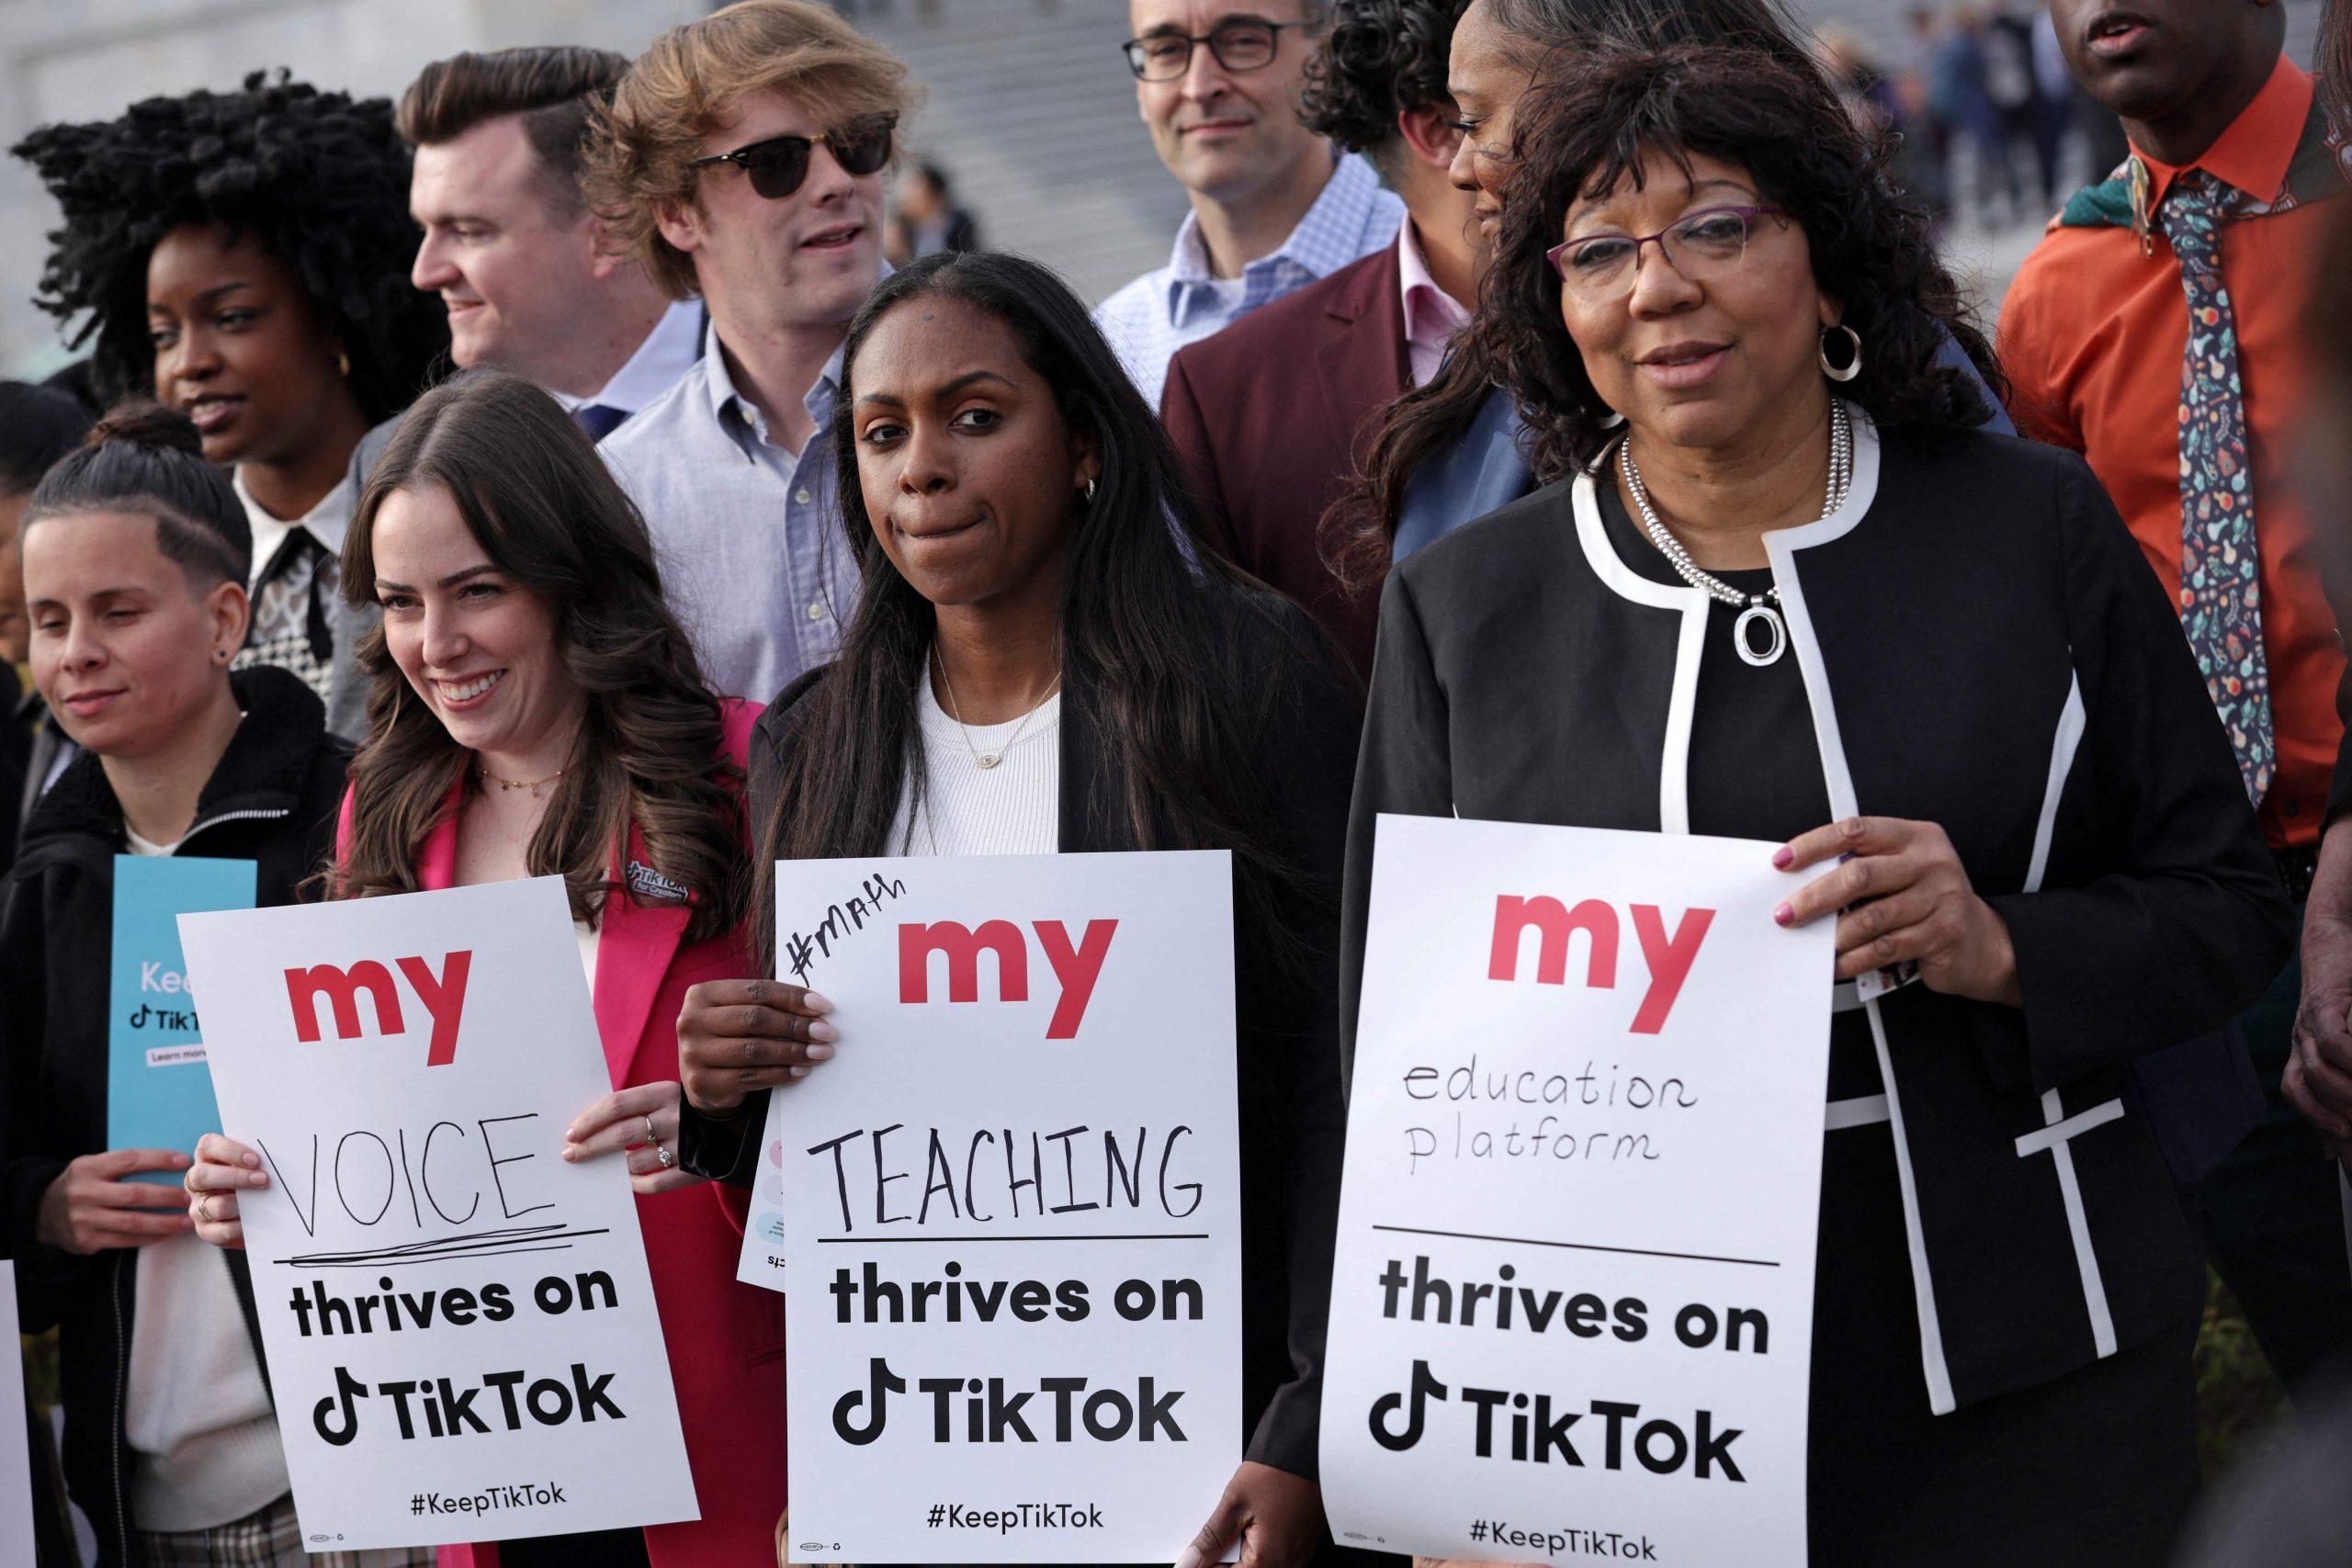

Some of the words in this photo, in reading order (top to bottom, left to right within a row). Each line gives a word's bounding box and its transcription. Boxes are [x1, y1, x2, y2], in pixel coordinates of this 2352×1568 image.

[650, 886, 683, 897] Creator
[899, 919, 1119, 1039] my
[1487, 895, 1717, 1035] my
[284, 950, 472, 1066] my
[152, 1052, 181, 1062] Learn
[1403, 1054, 1699, 1110] education
[257, 1112, 556, 1237] VOICE
[1405, 1111, 1660, 1175] platform
[807, 1123, 1204, 1233] TEACHING
[289, 1277, 514, 1337] thrives
[534, 1270, 618, 1314] on
[830, 1261, 1091, 1323] thrives
[1114, 1279, 1204, 1321] on
[1379, 1256, 1649, 1343] thrives
[1674, 1303, 1770, 1355] on
[379, 1363, 627, 1439] TikTok
[919, 1377, 1188, 1442] TikTok
[1462, 1387, 1747, 1483] TikTok
[411, 1482, 567, 1517] #KeepTikTok
[926, 1503, 1104, 1535] #KeepTikTok
[1470, 1519, 1657, 1561] #KeepTikTok
